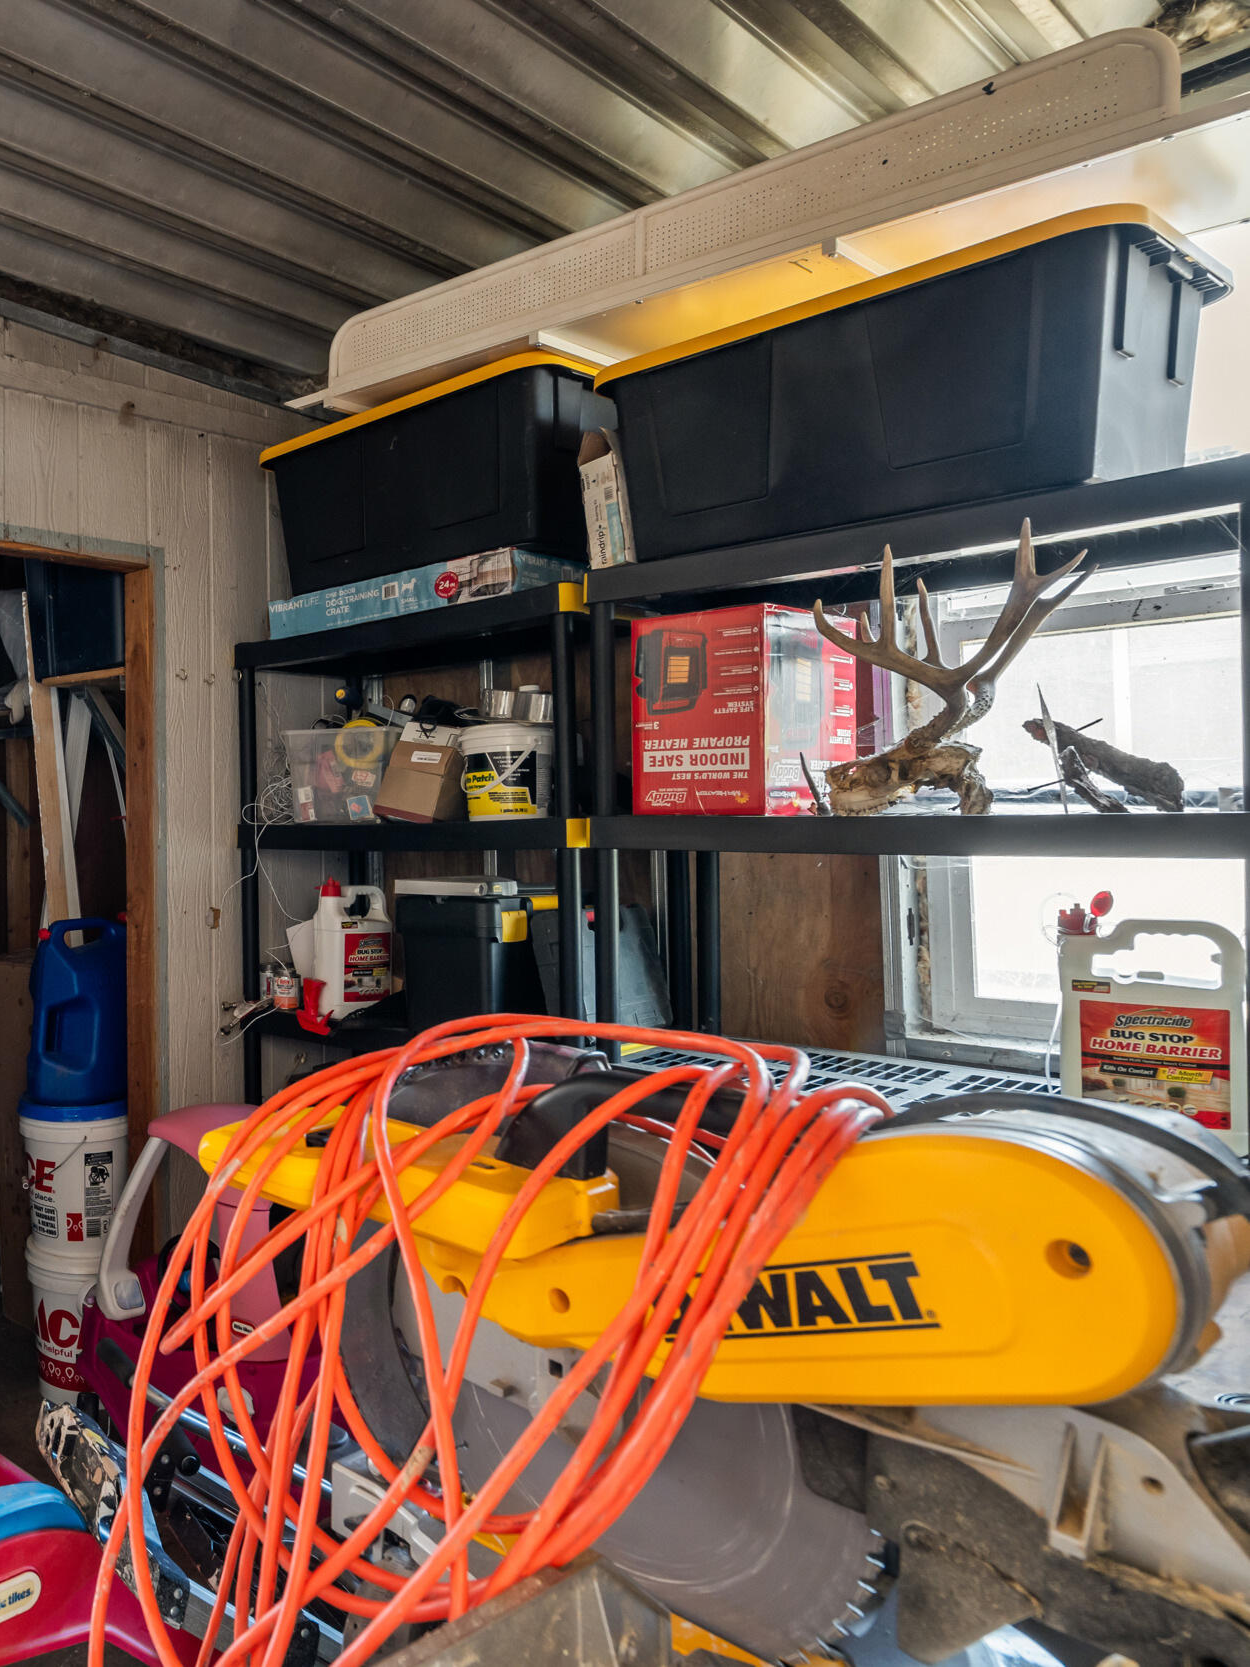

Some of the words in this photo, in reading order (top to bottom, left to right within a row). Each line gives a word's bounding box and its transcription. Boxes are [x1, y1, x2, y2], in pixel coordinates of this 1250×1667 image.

[597, 531, 608, 565] raindrip
[438, 580, 450, 590] 24
[325, 598, 343, 608] DOG
[345, 589, 380, 604] TRAINING
[325, 606, 350, 617] CRATE
[653, 722, 660, 730] 3
[692, 735, 750, 748] PROPANE
[649, 754, 684, 768] SAFE
[690, 752, 745, 767] INDOOR
[471, 773, 495, 783] Patch
[671, 772, 691, 781] BEST
[694, 772, 730, 780] WORLD'S
[733, 771, 748, 779] THE
[646, 790, 687, 804] Buddy
[1114, 1013, 1194, 1029] Spectracide
[1110, 1028, 1146, 1040] BUG
[1148, 1032, 1195, 1044] STOP
[1091, 1038, 1142, 1053] HOME
[1145, 1043, 1221, 1060] BARRIER
[1128, 1067, 1154, 1076] Contact
[1166, 1067, 1177, 1075] 12
[1178, 1070, 1203, 1078] Month
[1166, 1074, 1194, 1082] Control
[35, 1298, 84, 1350] AC
[43, 1342, 73, 1358] helpful
[8, 1588, 33, 1606] tikes
